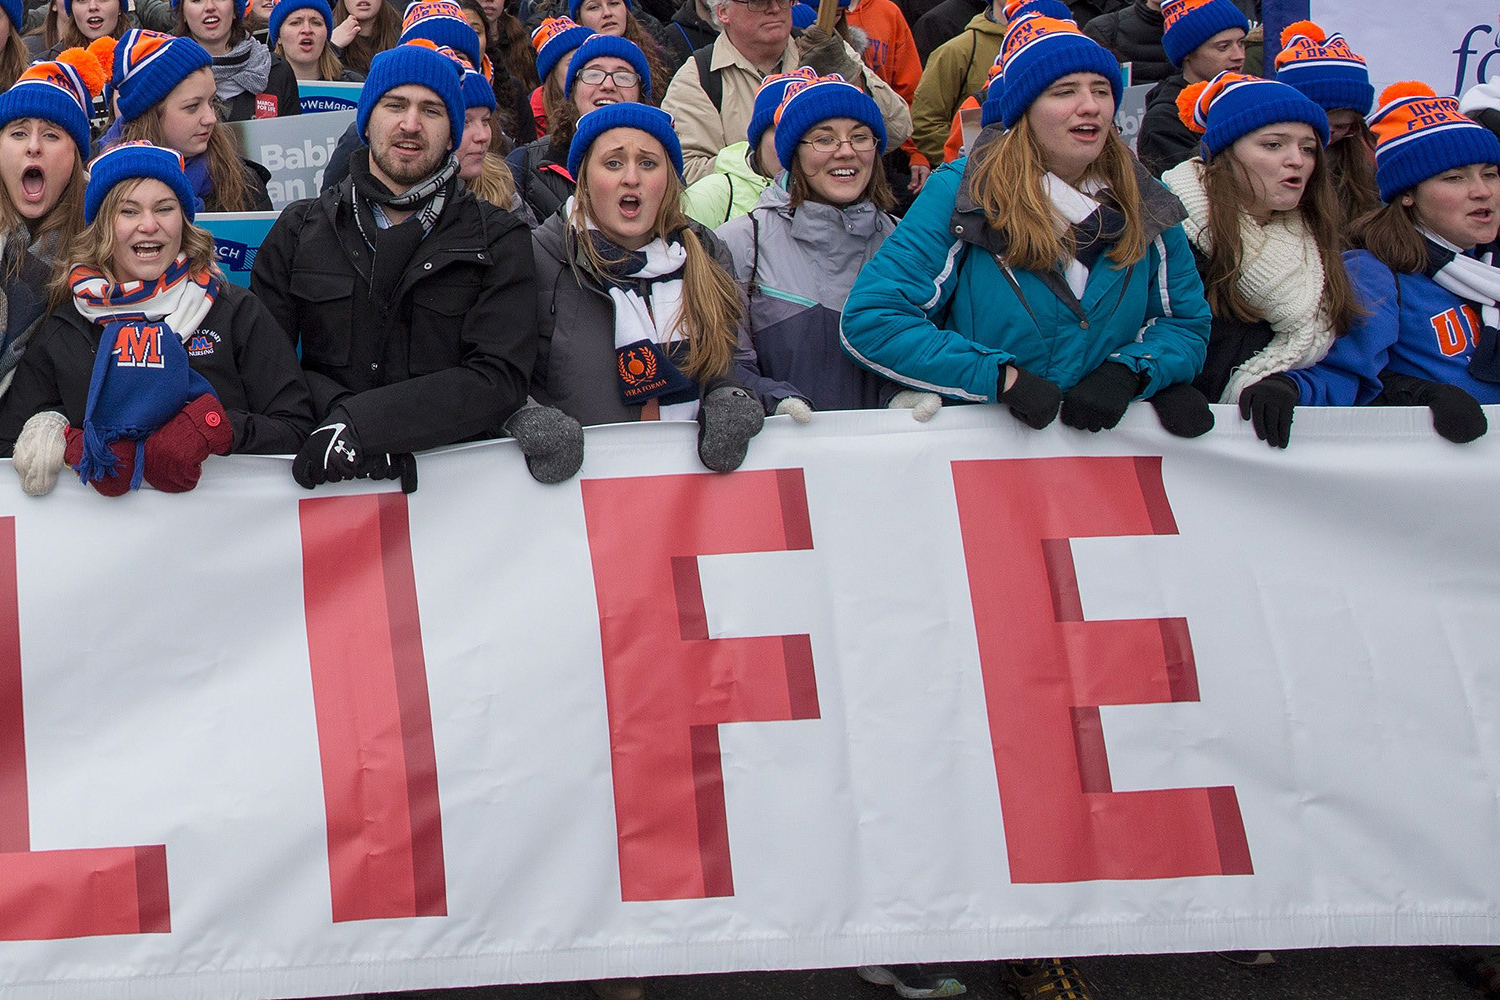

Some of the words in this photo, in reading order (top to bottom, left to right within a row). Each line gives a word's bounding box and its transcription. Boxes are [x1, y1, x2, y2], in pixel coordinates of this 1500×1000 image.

[260, 137, 335, 171] Babi
[267, 178, 306, 201] an
[189, 348, 214, 357] NURSING
